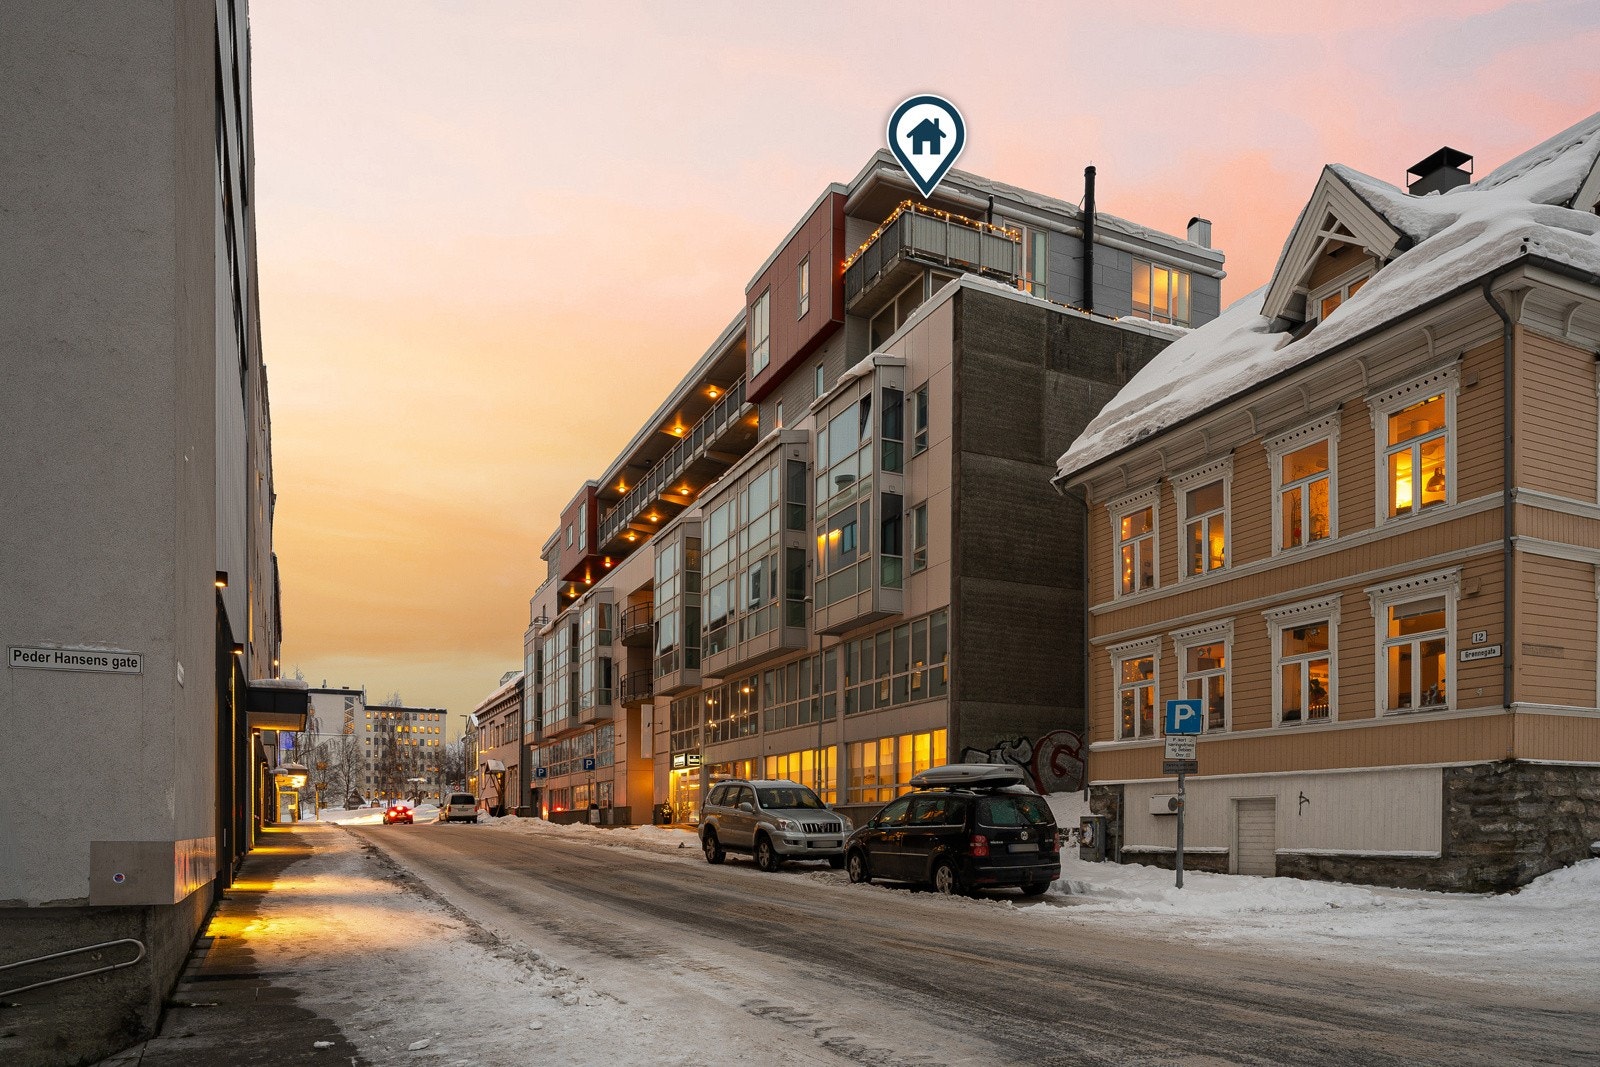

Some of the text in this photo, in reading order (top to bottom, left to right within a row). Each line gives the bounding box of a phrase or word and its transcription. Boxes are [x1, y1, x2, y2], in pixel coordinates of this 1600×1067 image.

[1475, 633, 1484, 642] 12
[13, 649, 138, 669] Peder Hansens gate
[1174, 704, 1193, 730] P
[586, 759, 593, 769] P
[538, 768, 545, 777] P
